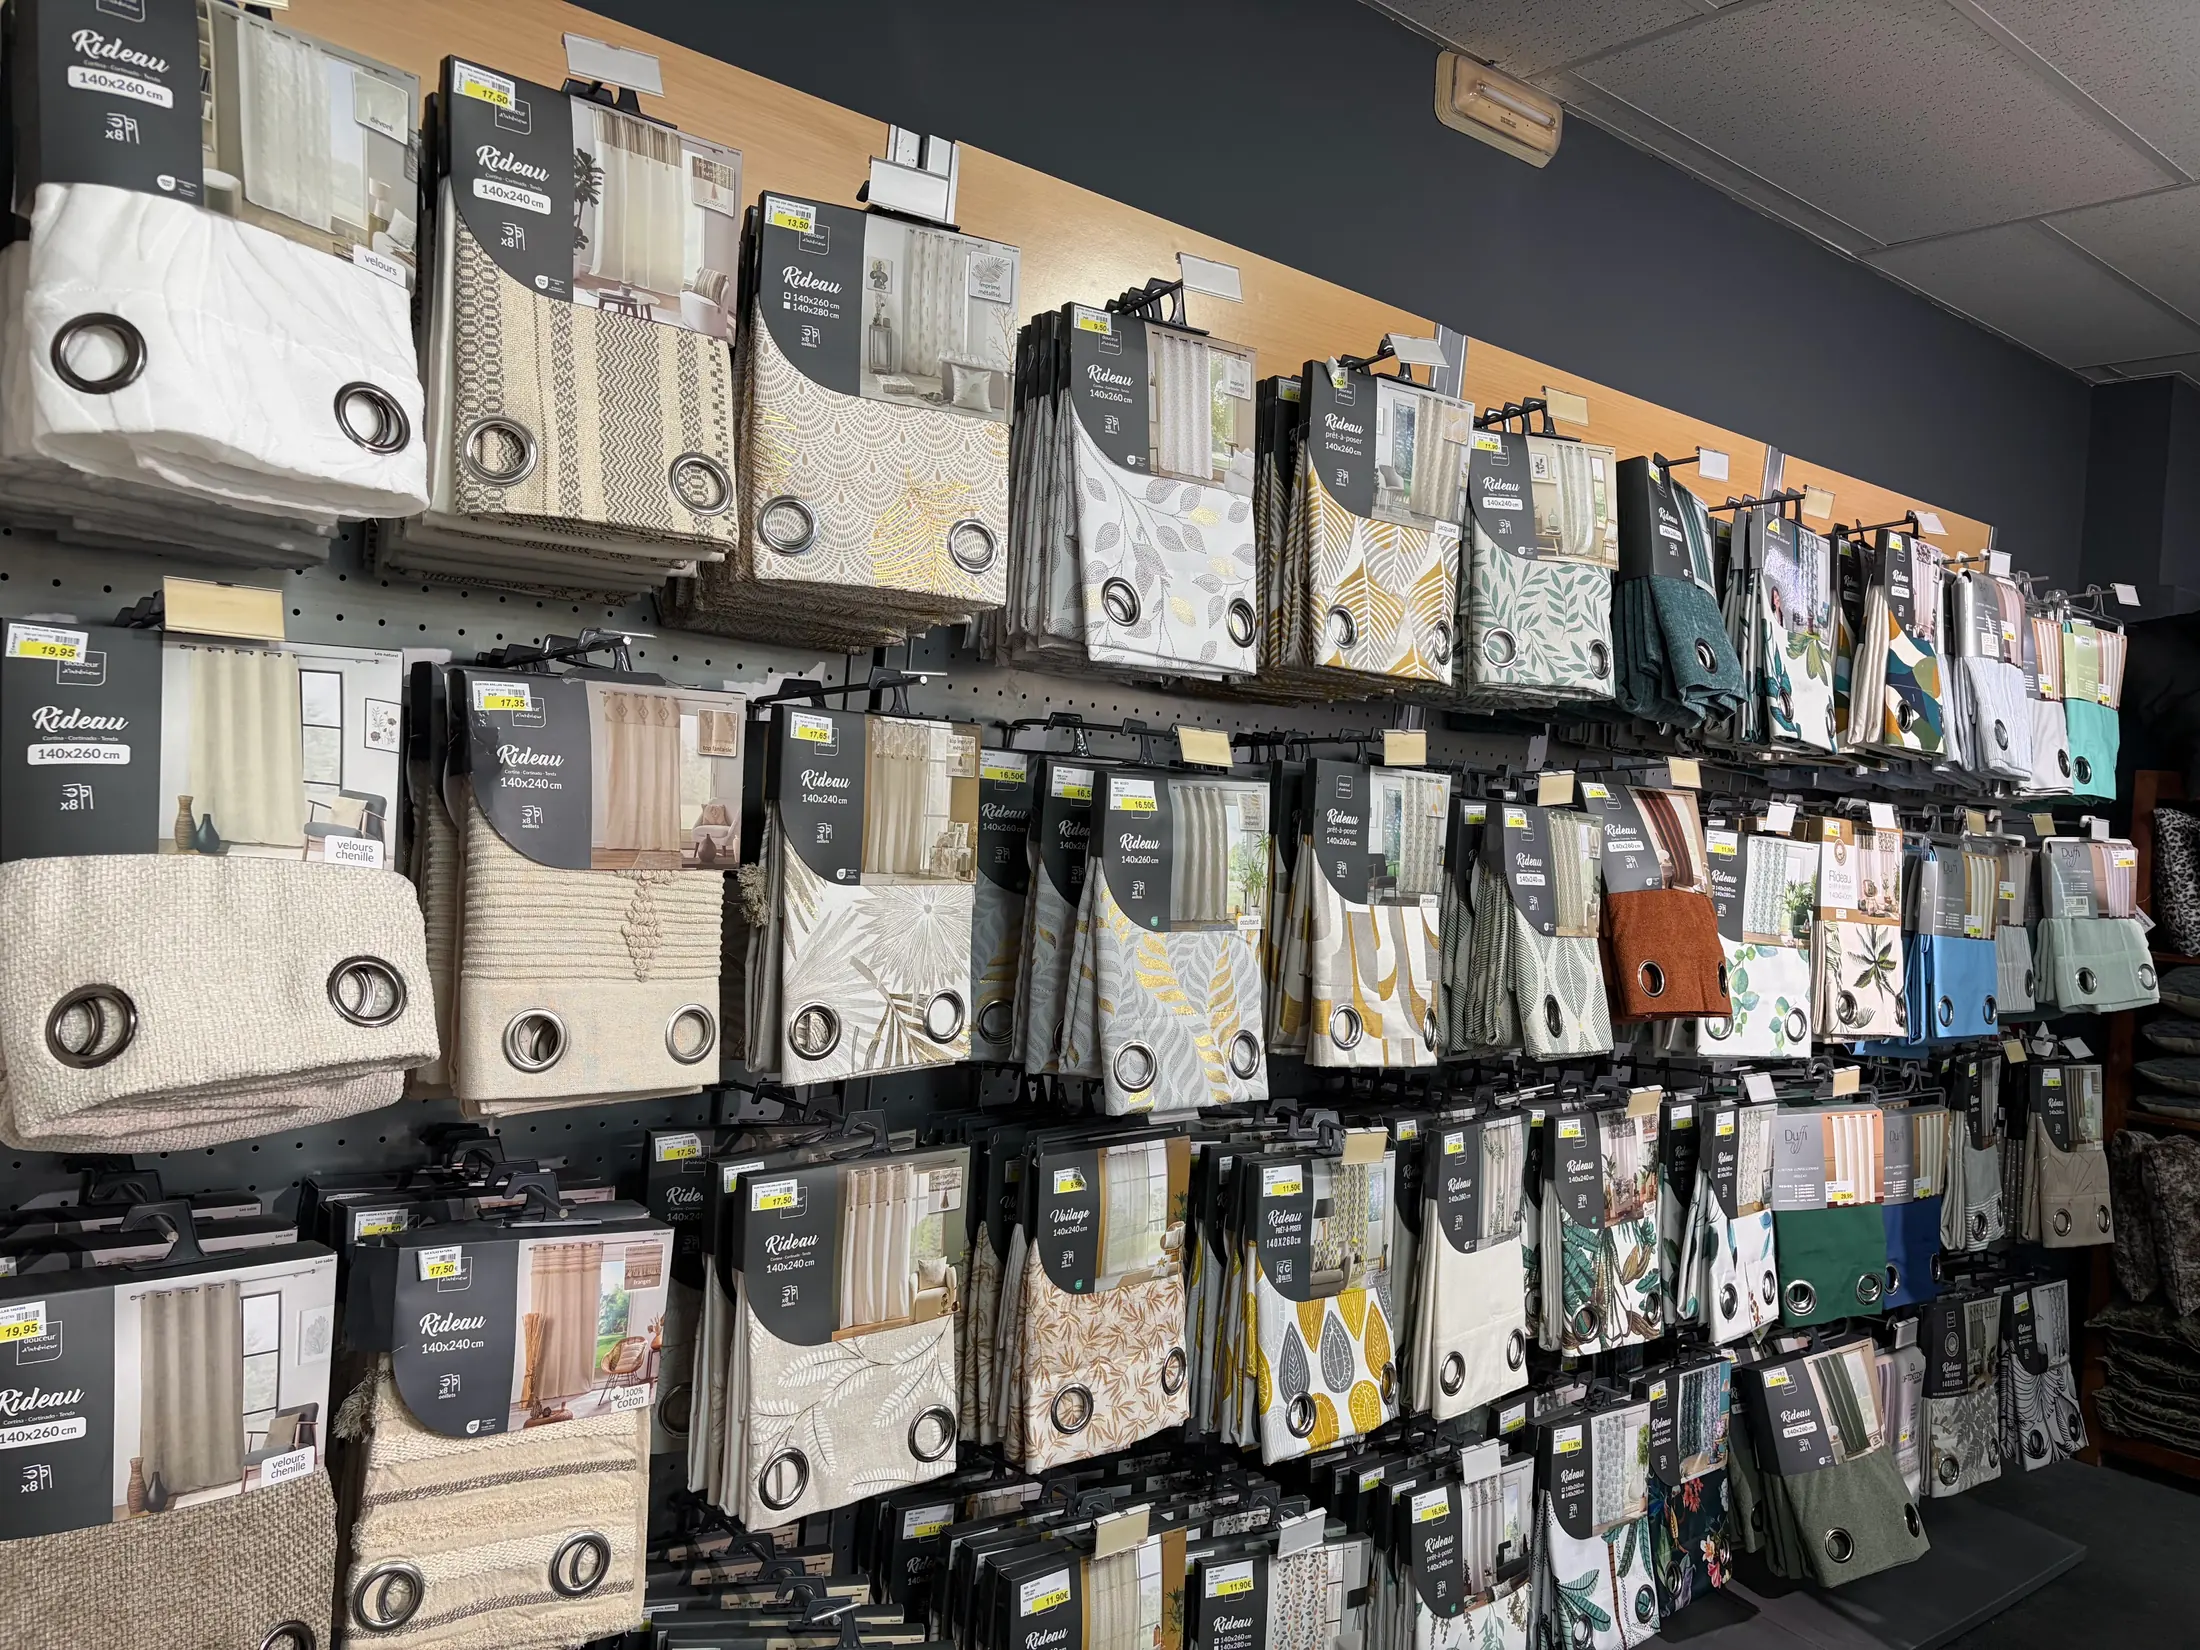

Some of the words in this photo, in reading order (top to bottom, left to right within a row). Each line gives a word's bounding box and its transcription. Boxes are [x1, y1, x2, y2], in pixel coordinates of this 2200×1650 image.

[71, 29, 170, 73] Rideau
[79, 71, 144, 95] 140x260
[146, 90, 163, 101] cm
[105, 129, 124, 141] x8
[476, 145, 549, 182] Rideau
[482, 183, 531, 205] 140x240
[531, 199, 544, 208] cm
[501, 237, 514, 248] x8
[364, 253, 397, 276] velours
[782, 265, 842, 294] Rideau
[793, 293, 829, 309] 140x260
[829, 302, 840, 311] cm
[792, 303, 829, 319] 140x280
[829, 312, 840, 320] cm
[1087, 364, 1134, 387] Rideau
[1089, 389, 1123, 403] 140x260
[1324, 412, 1364, 435] Rideau
[1325, 431, 1362, 445] prêt-à-poser
[1325, 442, 1354, 454] 140x260
[1483, 476, 1520, 492] Rideau
[1487, 499, 1512, 507] 140x240
[32, 705, 129, 733] Rideau
[38, 748, 101, 760] 140x260
[496, 744, 564, 768] Rideau
[801, 769, 851, 790] Rideau
[1000, 770, 1025, 781] 16,50€
[500, 777, 549, 790] 140x240
[549, 783, 562, 791] cm
[60, 799, 79, 811] x8
[802, 793, 838, 804] 140x240
[1135, 800, 1156, 810] 16,50€
[981, 802, 1028, 820] Rideau
[1326, 808, 1360, 826] Rideau
[983, 822, 1017, 833] 140x260
[1059, 819, 1091, 838] Ridea
[1327, 826, 1357, 835] prêt-à-poser
[1604, 823, 1638, 837] Rideau
[337, 840, 374, 853] velours
[1120, 832, 1160, 851] Rideau
[1326, 836, 1350, 846] 140x260
[335, 851, 375, 864] chenille
[1121, 855, 1151, 864] 140x260
[1516, 852, 1543, 867] Rideau
[1711, 869, 1738, 884] Rideau
[1829, 869, 1851, 884] Rideau
[1567, 1160, 1594, 1174] Rideau
[1447, 1177, 1471, 1193] Rideau
[1050, 1207, 1090, 1225] Voilage
[1268, 1209, 1303, 1227] Rideau
[1053, 1225, 1080, 1237] 140x240
[765, 1233, 819, 1255] Rideau
[766, 1258, 804, 1273] 140x240
[633, 1278, 652, 1286] franges
[419, 1312, 486, 1337] Rideau
[422, 1339, 470, 1354] 140x240
[471, 1340, 484, 1348] cm
[626, 1387, 644, 1397] 100%
[0, 1387, 85, 1417] Rideau
[617, 1394, 644, 1408] coton
[3, 1418, 25, 1426] Cortina
[28, 1414, 56, 1422] Cortinado
[1780, 1408, 1811, 1423] Rideau
[1651, 1417, 1672, 1431] Rideau
[0, 1425, 60, 1444] 140x260
[61, 1428, 77, 1436] cm
[272, 1453, 305, 1470] velours
[271, 1462, 306, 1479] chenille
[1561, 1468, 1585, 1483] Rideau
[20, 1480, 38, 1493] x8
[1425, 1535, 1454, 1553] Rideau
[1427, 1559, 1447, 1572] 140x240
[1230, 1580, 1252, 1591] 11,90€
[1046, 1590, 1069, 1605] 11,90€
[1213, 1616, 1253, 1633] Rideau
[1025, 1628, 1069, 1650] Rideau
[1220, 1634, 1245, 1644] 140x260
